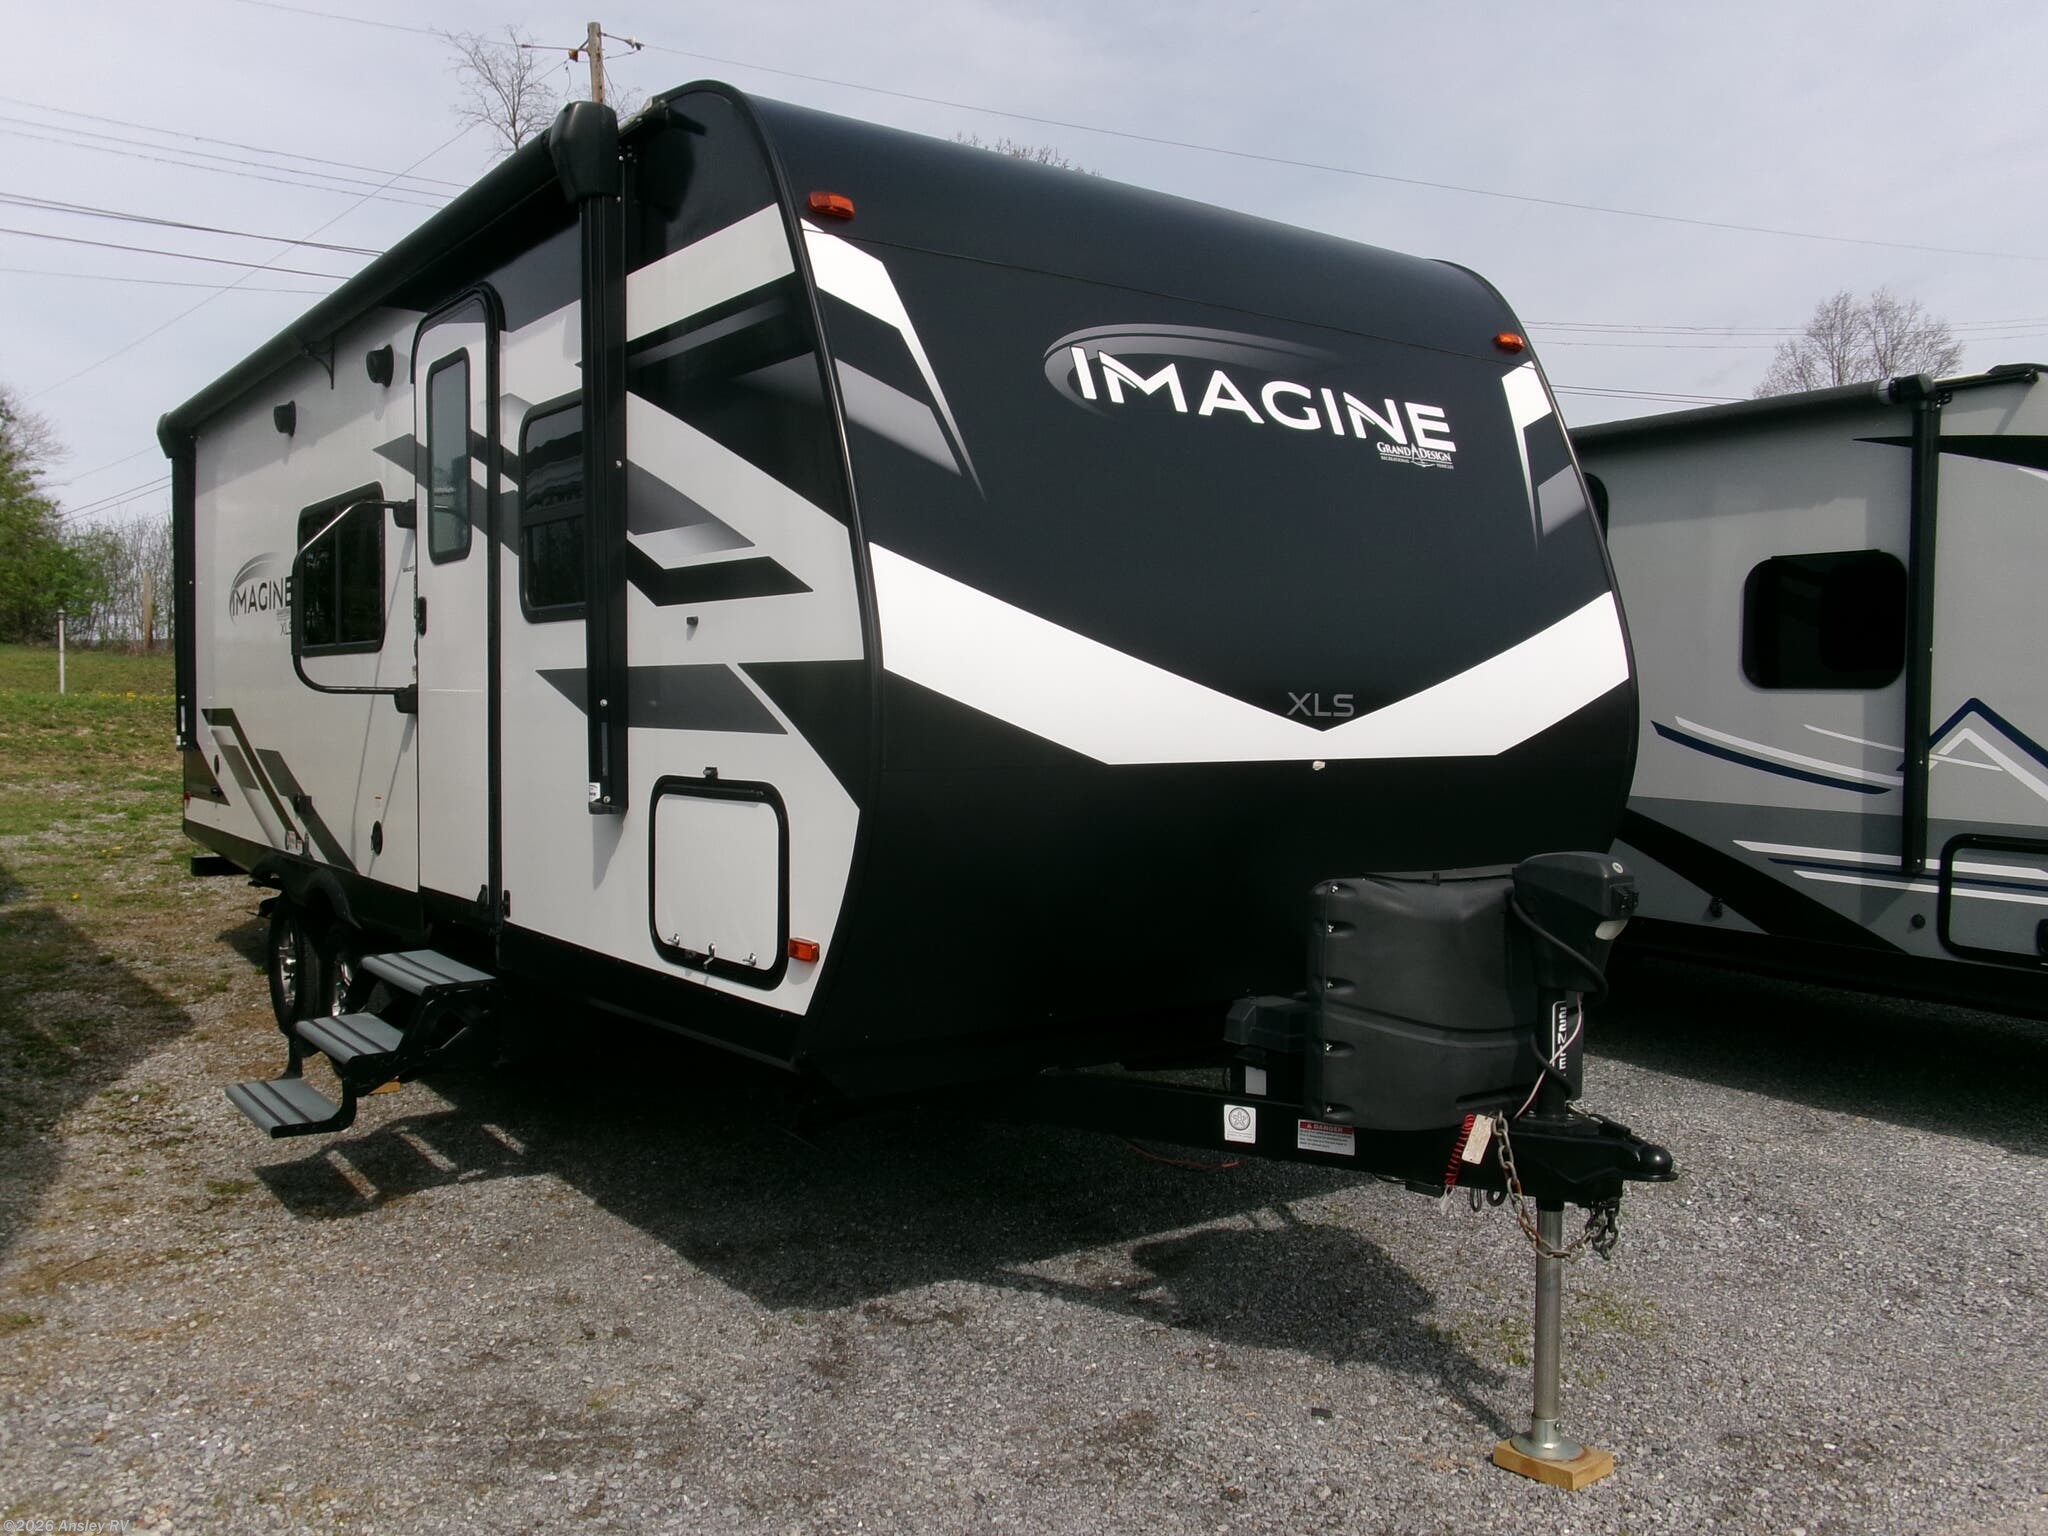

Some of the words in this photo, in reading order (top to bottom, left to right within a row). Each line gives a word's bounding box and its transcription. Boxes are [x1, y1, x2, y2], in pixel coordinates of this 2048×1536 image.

[1071, 346, 1456, 452] IMAGINE
[1376, 441, 1411, 456] GRAND
[1419, 448, 1452, 461] DESIGN
[232, 577, 292, 616] IMAGINE
[1287, 692, 1354, 717] XLS
